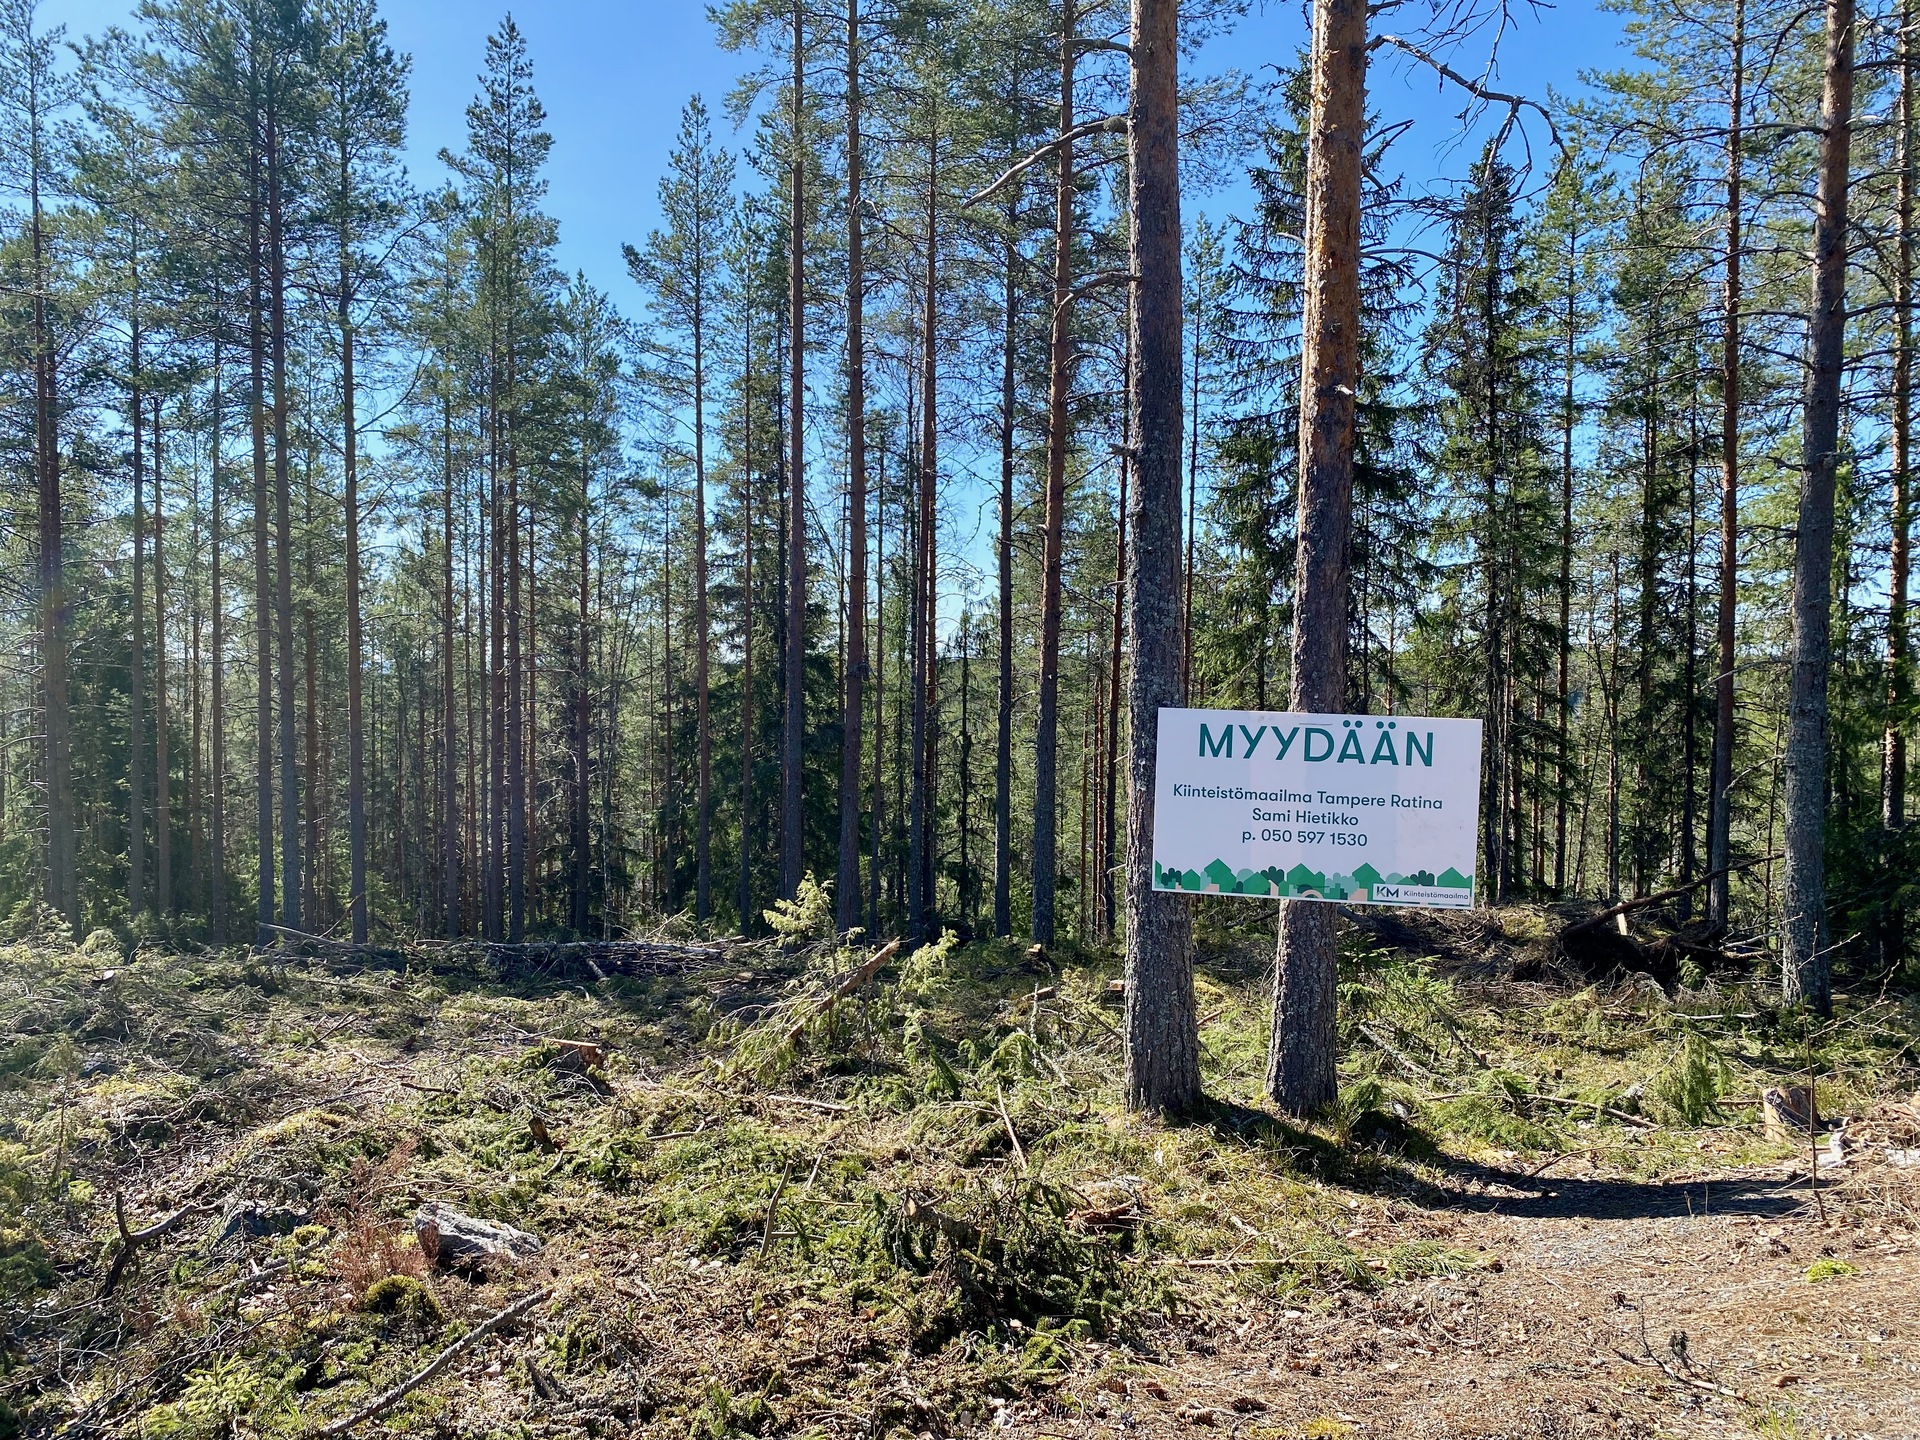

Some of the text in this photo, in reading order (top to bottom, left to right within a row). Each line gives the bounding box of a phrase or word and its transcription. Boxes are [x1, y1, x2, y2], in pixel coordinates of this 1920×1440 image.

[1199, 719, 1434, 767] MYYDÄÄN
[1173, 783, 1443, 810] Kiinteistömaailma Tampere Ratina
[1252, 808, 1359, 826] Sami Hietikko
[1241, 829, 1368, 847] p. 050 597 1530
[1376, 886, 1469, 900] KM Kiinteistömaailma
